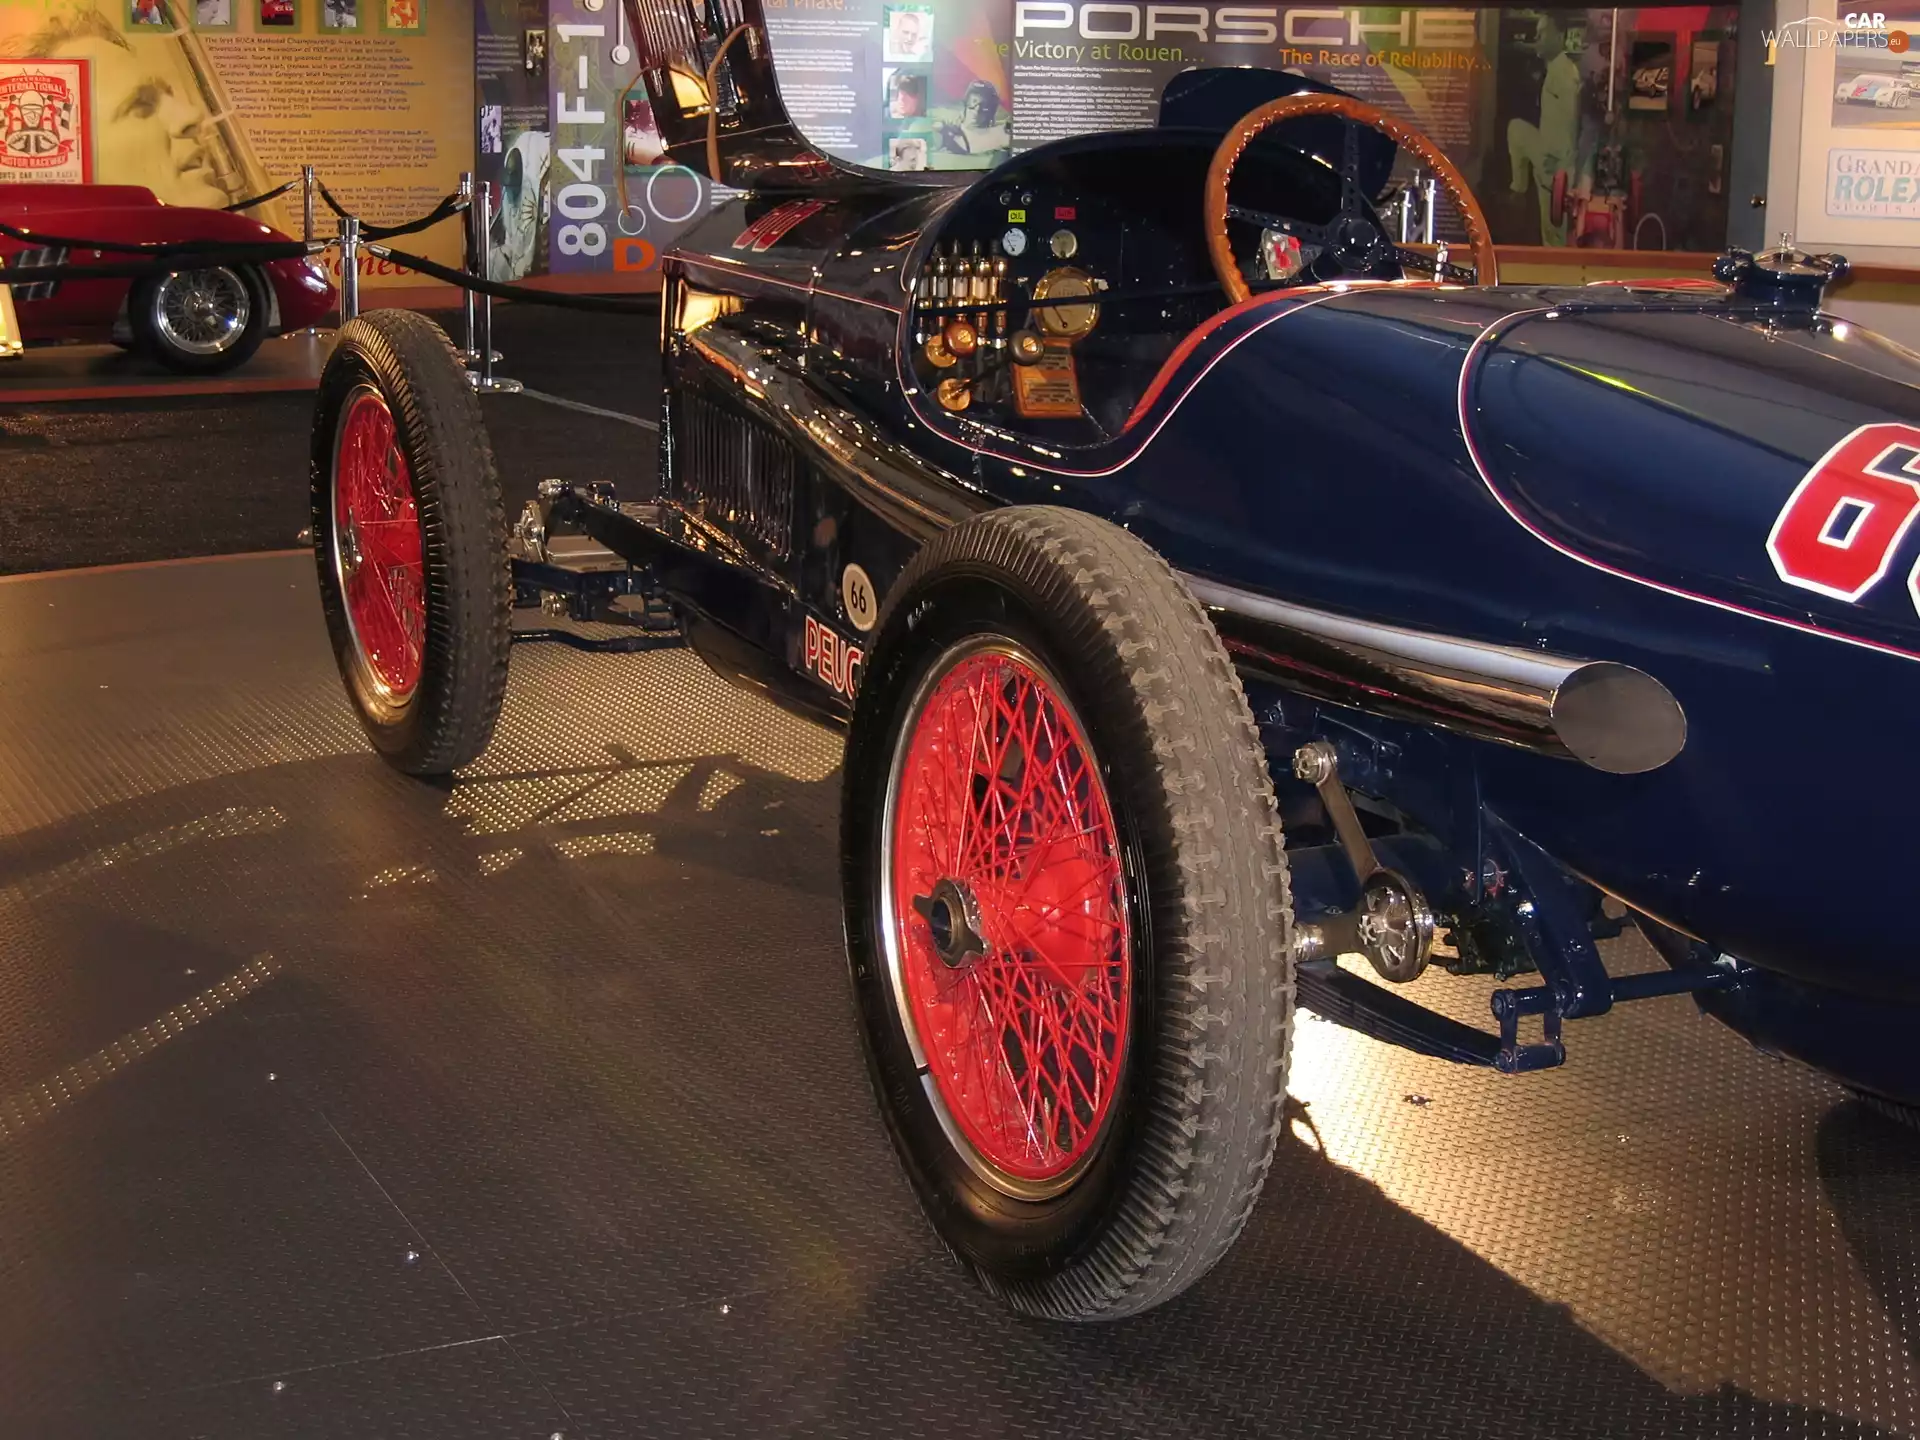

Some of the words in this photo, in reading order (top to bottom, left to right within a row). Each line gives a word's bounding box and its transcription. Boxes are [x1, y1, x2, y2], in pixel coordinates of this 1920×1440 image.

[1015, 2, 1476, 48] PORSCHE
[557, 23, 605, 124] F-1
[1014, 40, 1084, 64] Victory
[1090, 45, 1111, 61] at
[1117, 43, 1206, 63] Rouen...
[1279, 48, 1313, 65] The
[1319, 50, 1361, 67] Race
[1366, 50, 1386, 67] of
[557, 145, 606, 257] 804
[1765, 422, 1920, 620] 6
[850, 581, 867, 614] 66
